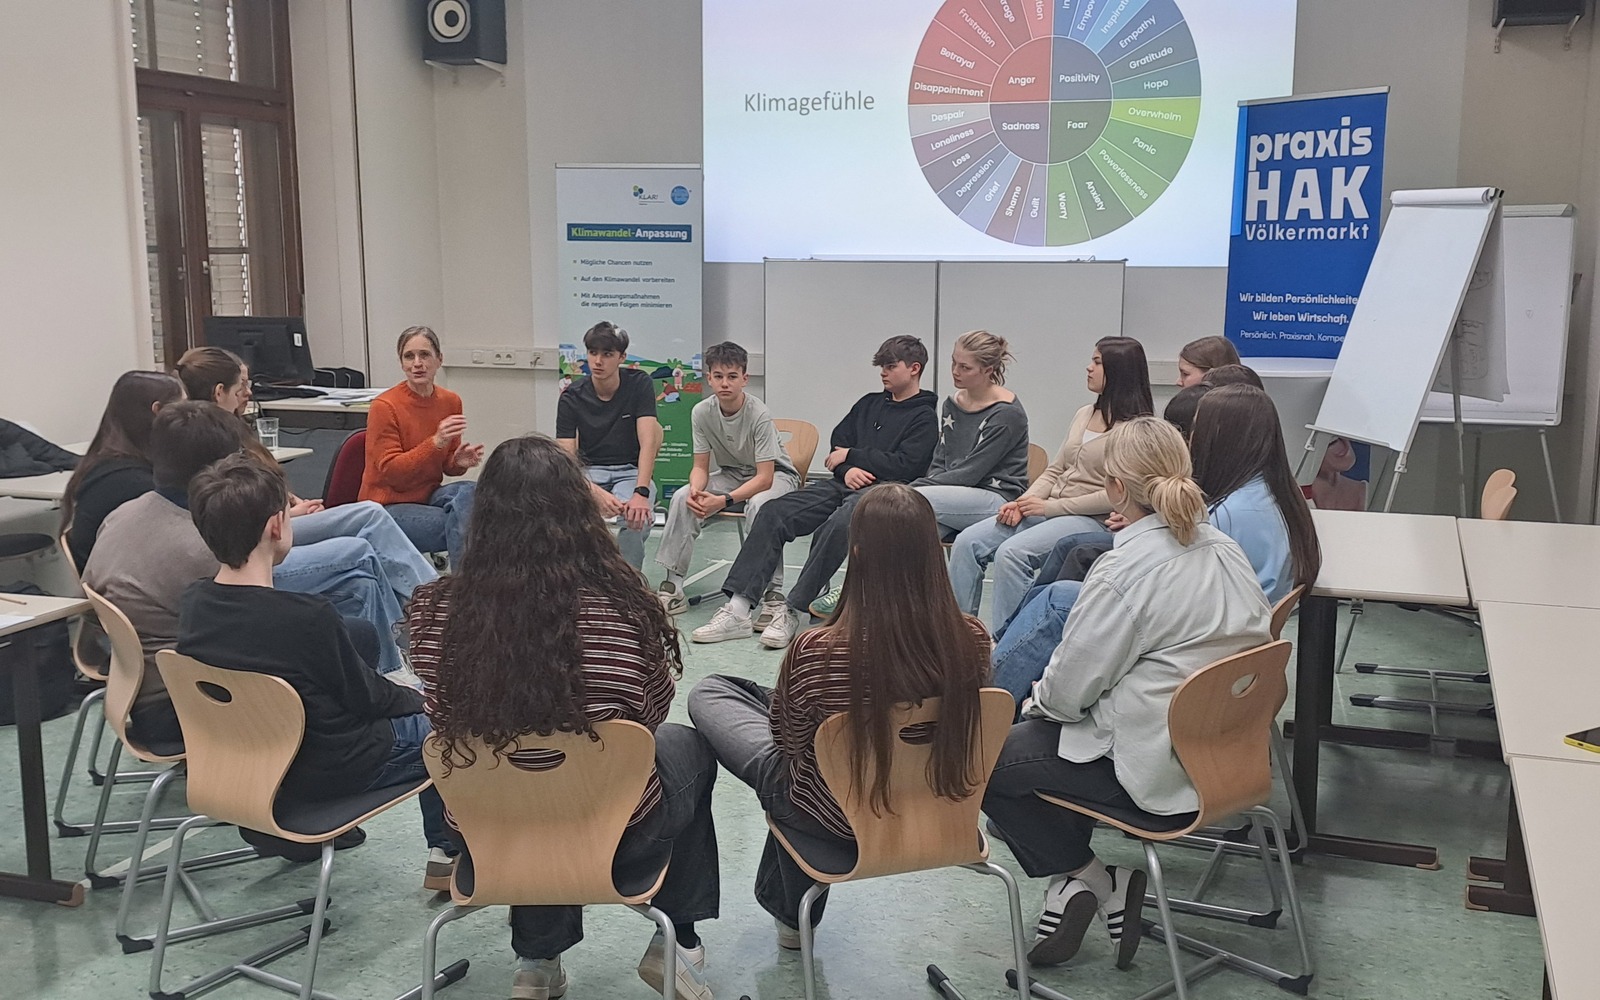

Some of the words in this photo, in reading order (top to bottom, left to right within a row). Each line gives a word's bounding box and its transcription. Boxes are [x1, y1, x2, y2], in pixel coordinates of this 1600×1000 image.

[1036, 0, 1044, 20] tion
[1062, 0, 1070, 9] In
[1100, 0, 1129, 34] Inspirat
[958, 8, 996, 47] Frustration
[1119, 15, 1156, 48] Empathy
[940, 47, 975, 69] Betrayal
[1129, 46, 1173, 69] Gratitude
[1008, 76, 1036, 87] Anger
[1059, 73, 1100, 84] Positivity
[1143, 79, 1169, 90] Hope
[914, 82, 984, 97] Disappointment
[745, 90, 875, 116] Klimagefühle
[931, 110, 965, 122] Despair
[1128, 107, 1181, 121] Overwhelm
[1002, 122, 1040, 131] Sadness
[1067, 121, 1088, 129] Fear
[931, 128, 974, 150] Loneliness
[1132, 137, 1157, 155] Panic
[1248, 116, 1372, 171] praxis
[952, 153, 971, 167] Loss
[956, 159, 994, 197] Depression
[1099, 149, 1148, 199] Powerlessness
[985, 181, 1001, 202] Grief
[1005, 186, 1022, 216] Shame
[1086, 181, 1105, 211] Anxiety
[1245, 165, 1371, 221] HAK
[1030, 197, 1040, 218] Guilt
[1058, 192, 1068, 220] Worry
[571, 228, 688, 240] Klimawandel-Anpassung
[1245, 222, 1369, 241] Völkermarkt
[620, 301, 639, 309] Folgen
[1239, 292, 1254, 302] Wir
[1255, 293, 1283, 303] bilden
[1285, 293, 1360, 305] Persönlichkeite
[1252, 311, 1268, 321] Wir
[1269, 311, 1295, 322] leben
[1297, 312, 1349, 325] Wirtschaft.
[1240, 330, 1278, 340] Persönlich.
[1280, 332, 1315, 341] Praxisnah.
[1317, 333, 1345, 343] Kompe
